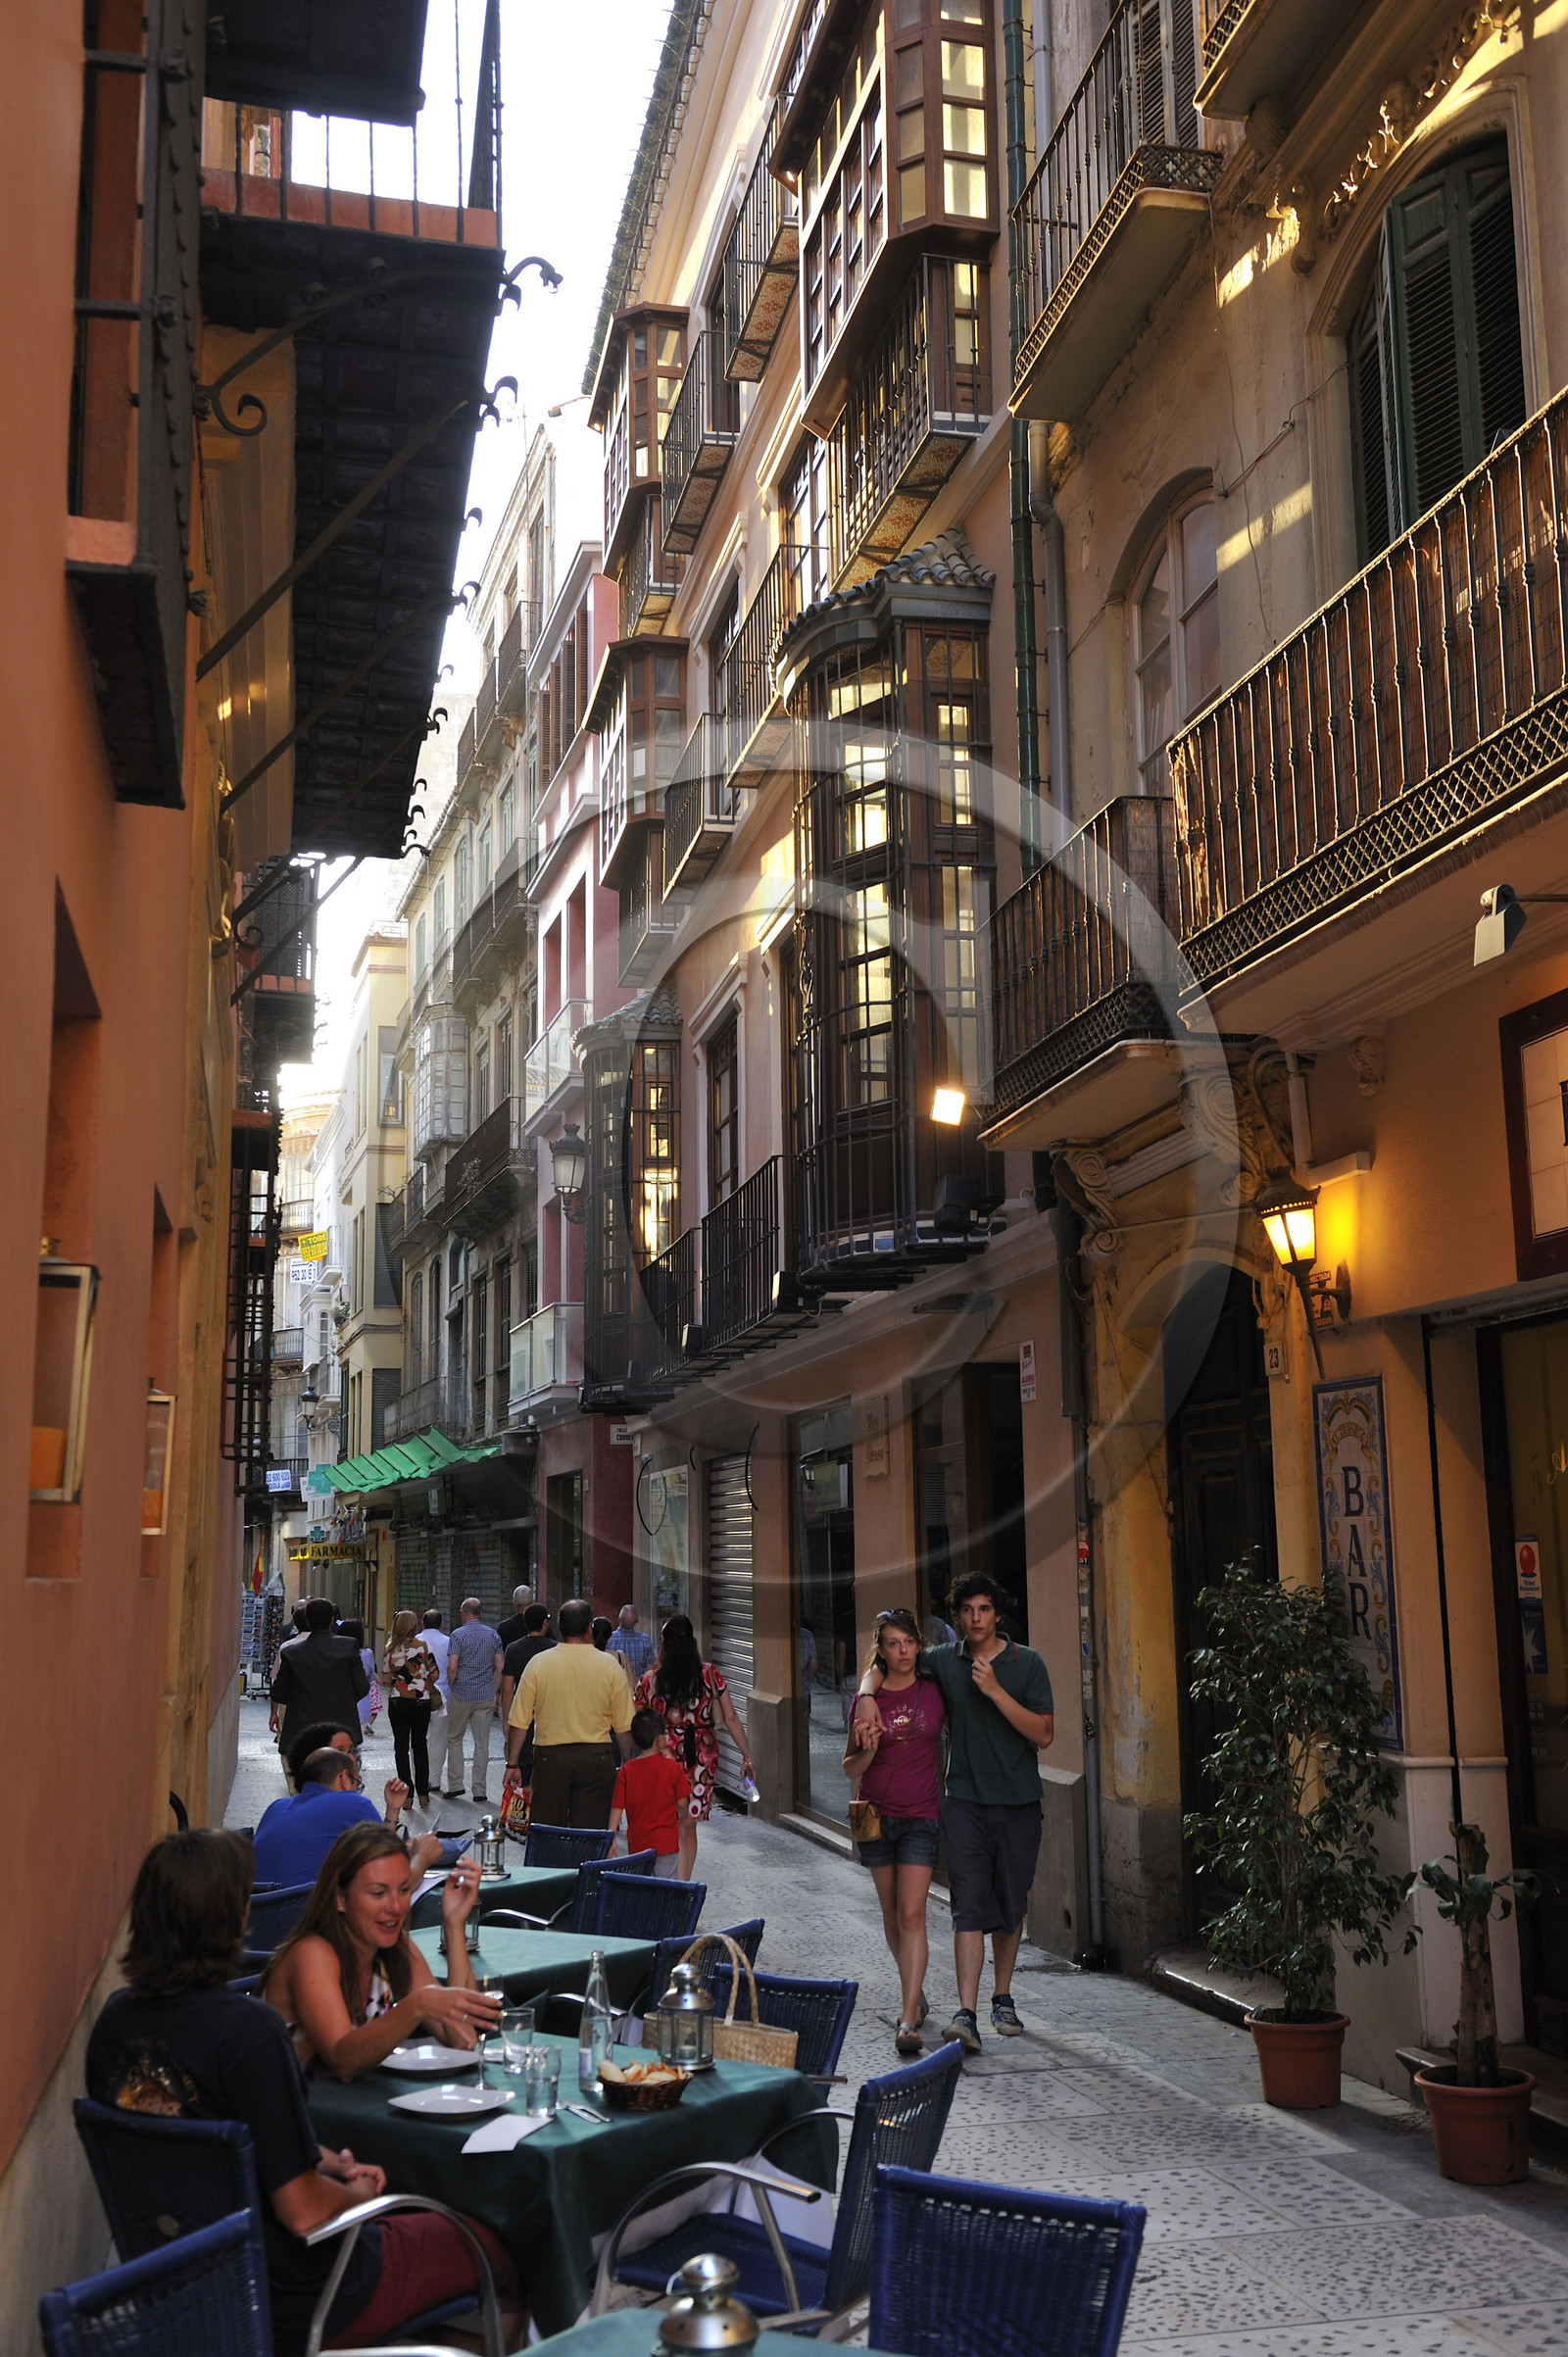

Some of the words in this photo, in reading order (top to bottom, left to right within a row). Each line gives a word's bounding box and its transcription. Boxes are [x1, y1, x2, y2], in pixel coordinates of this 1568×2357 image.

[1268, 1348, 1279, 1369] 23
[311, 1546, 362, 1557] FARMACIA
[1341, 1466, 1372, 1641] BAR
